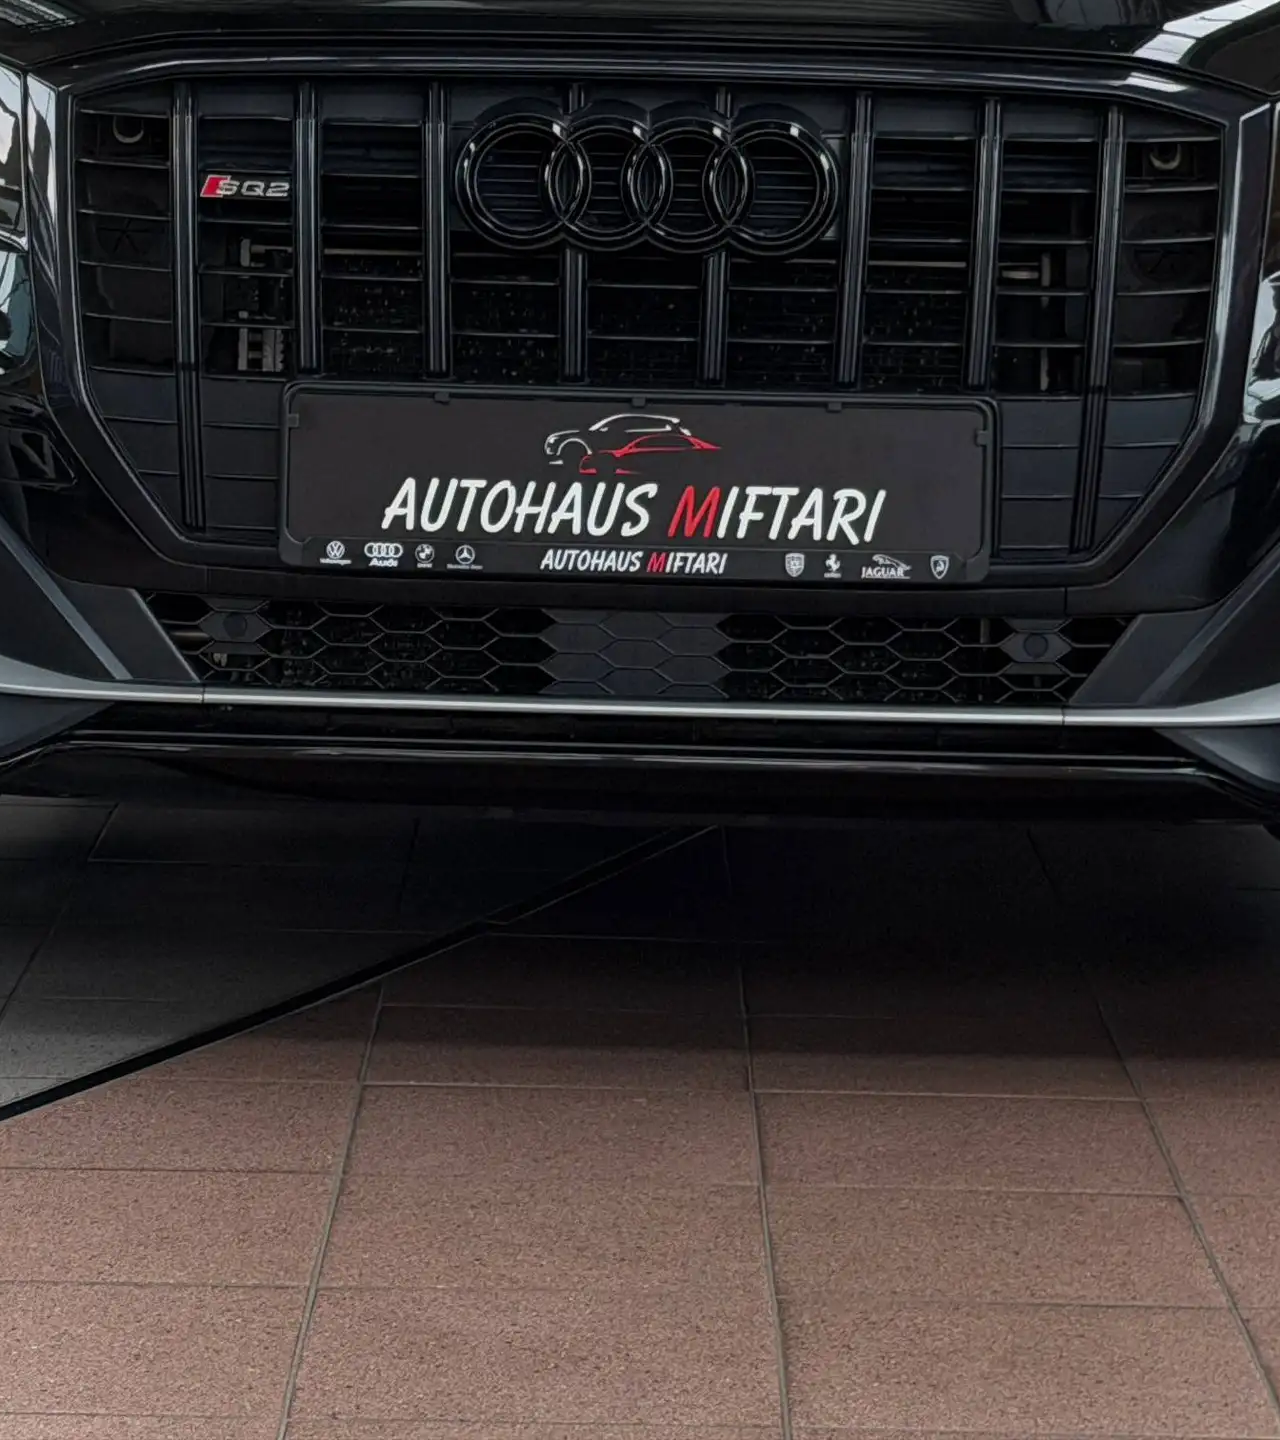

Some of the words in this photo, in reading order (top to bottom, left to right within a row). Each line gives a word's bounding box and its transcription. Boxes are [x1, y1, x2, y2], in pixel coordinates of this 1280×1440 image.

[215, 180, 290, 197] SQ2
[381, 477, 658, 537] AUTOHAUS
[668, 485, 887, 546] MIFTARI
[540, 549, 644, 573] AUTOHAUS
[647, 552, 729, 575] MIFTARI
[861, 566, 904, 578] JAGUAR
